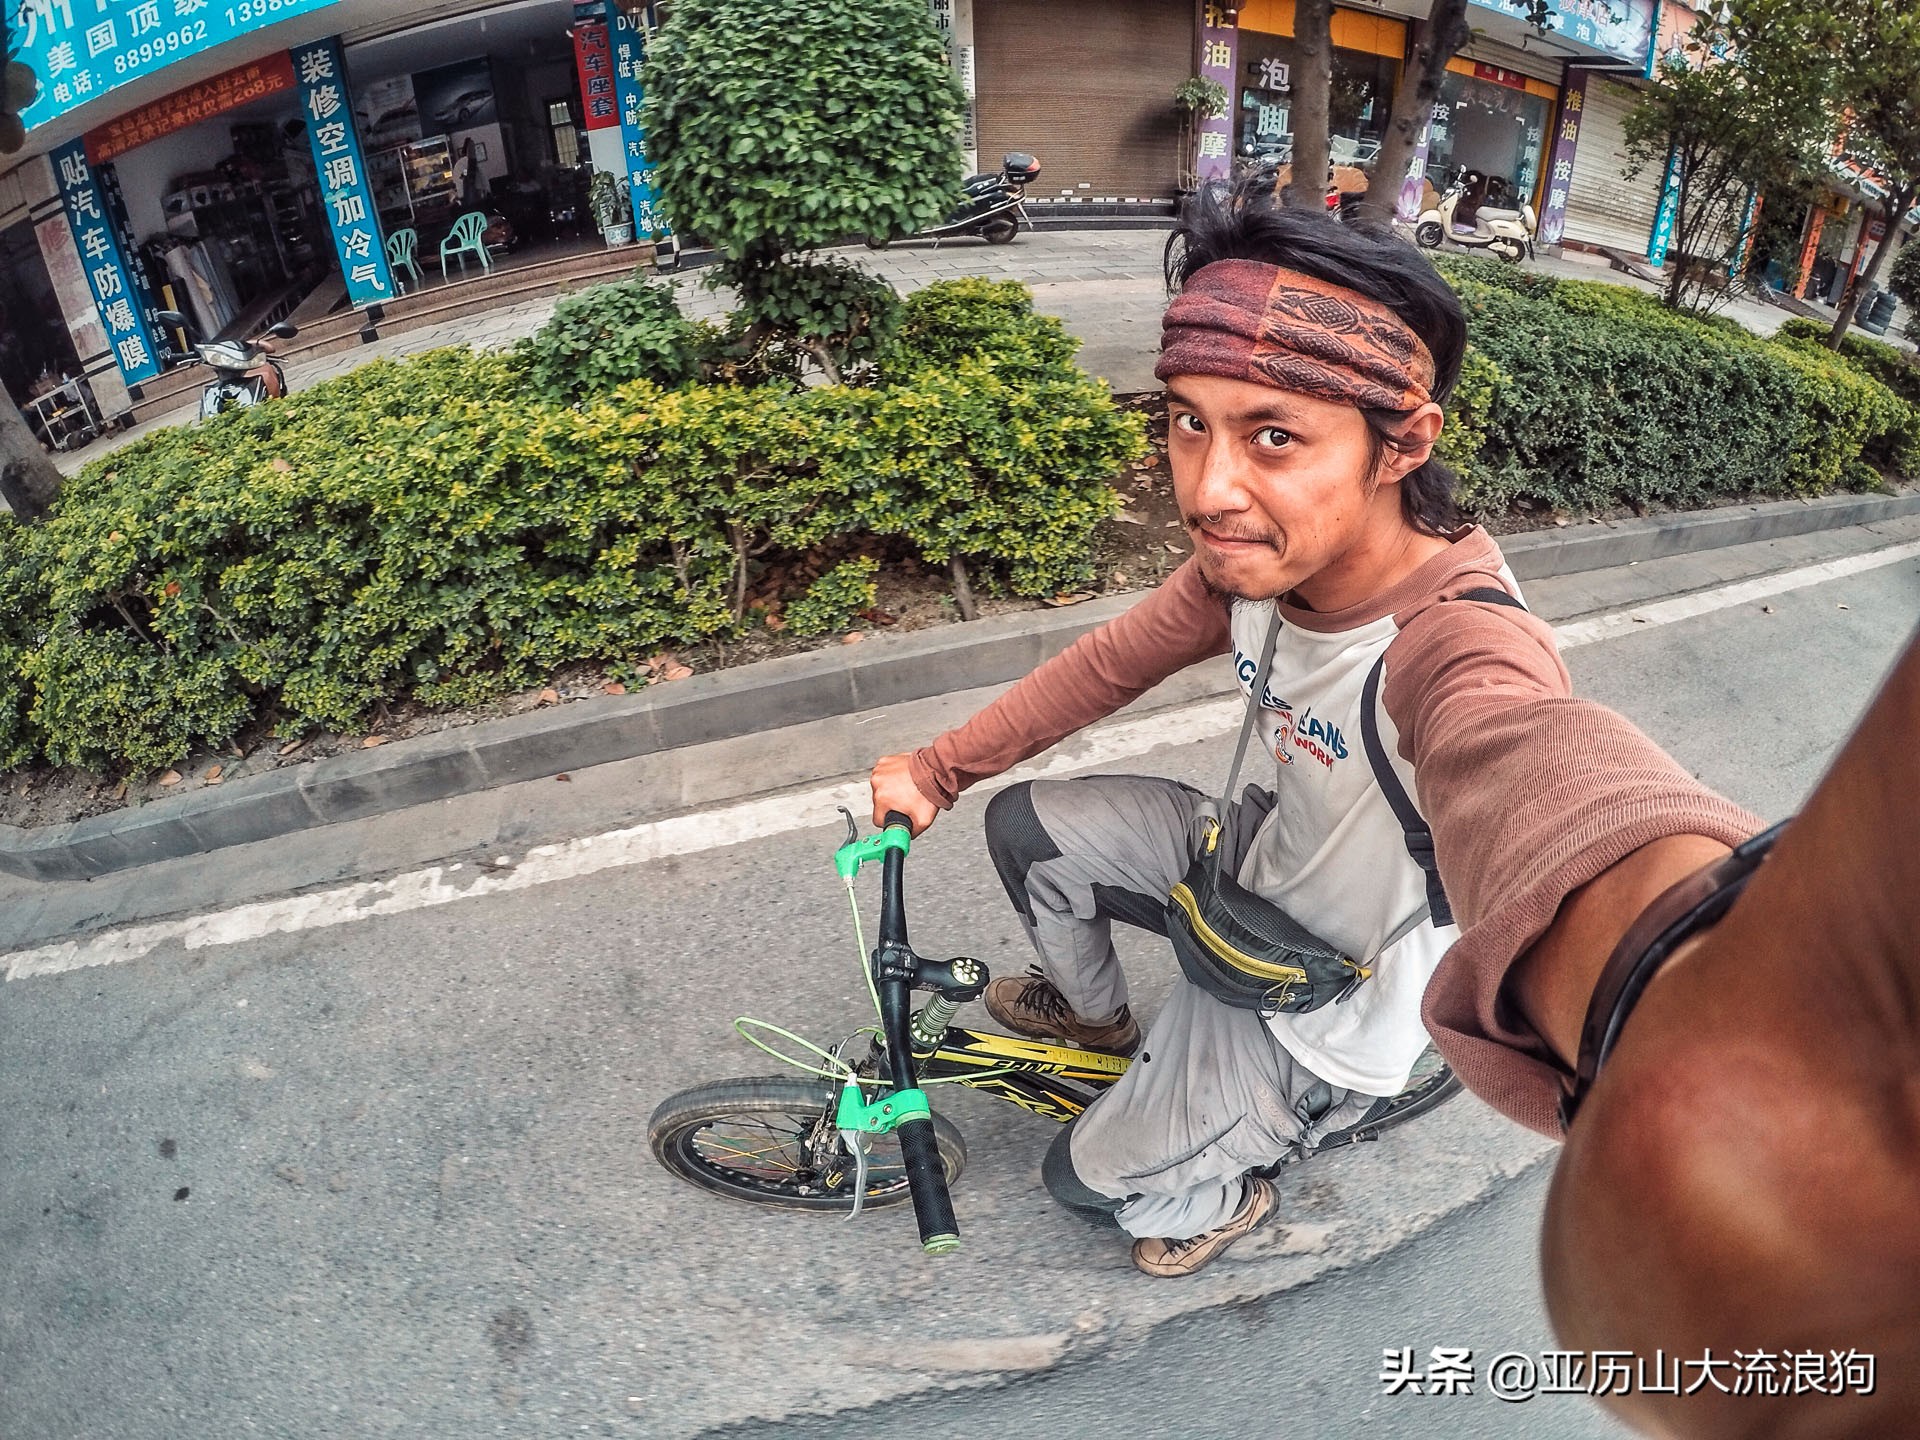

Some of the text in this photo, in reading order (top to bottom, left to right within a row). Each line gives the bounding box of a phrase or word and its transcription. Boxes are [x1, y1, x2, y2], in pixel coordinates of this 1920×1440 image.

[114, 20, 207, 74] 8899962
[225, 0, 296, 27] 1398
[580, 31, 614, 118] 汽车座套
[1199, 4, 1234, 159] 推油摩
[1256, 58, 1294, 138] 泡脚
[1549, 89, 1582, 210] 推油按摩
[301, 49, 385, 292] 装修空调加冷气
[59, 151, 150, 372] 贴汽车防爆膜
[1294, 734, 1334, 772] WORK
